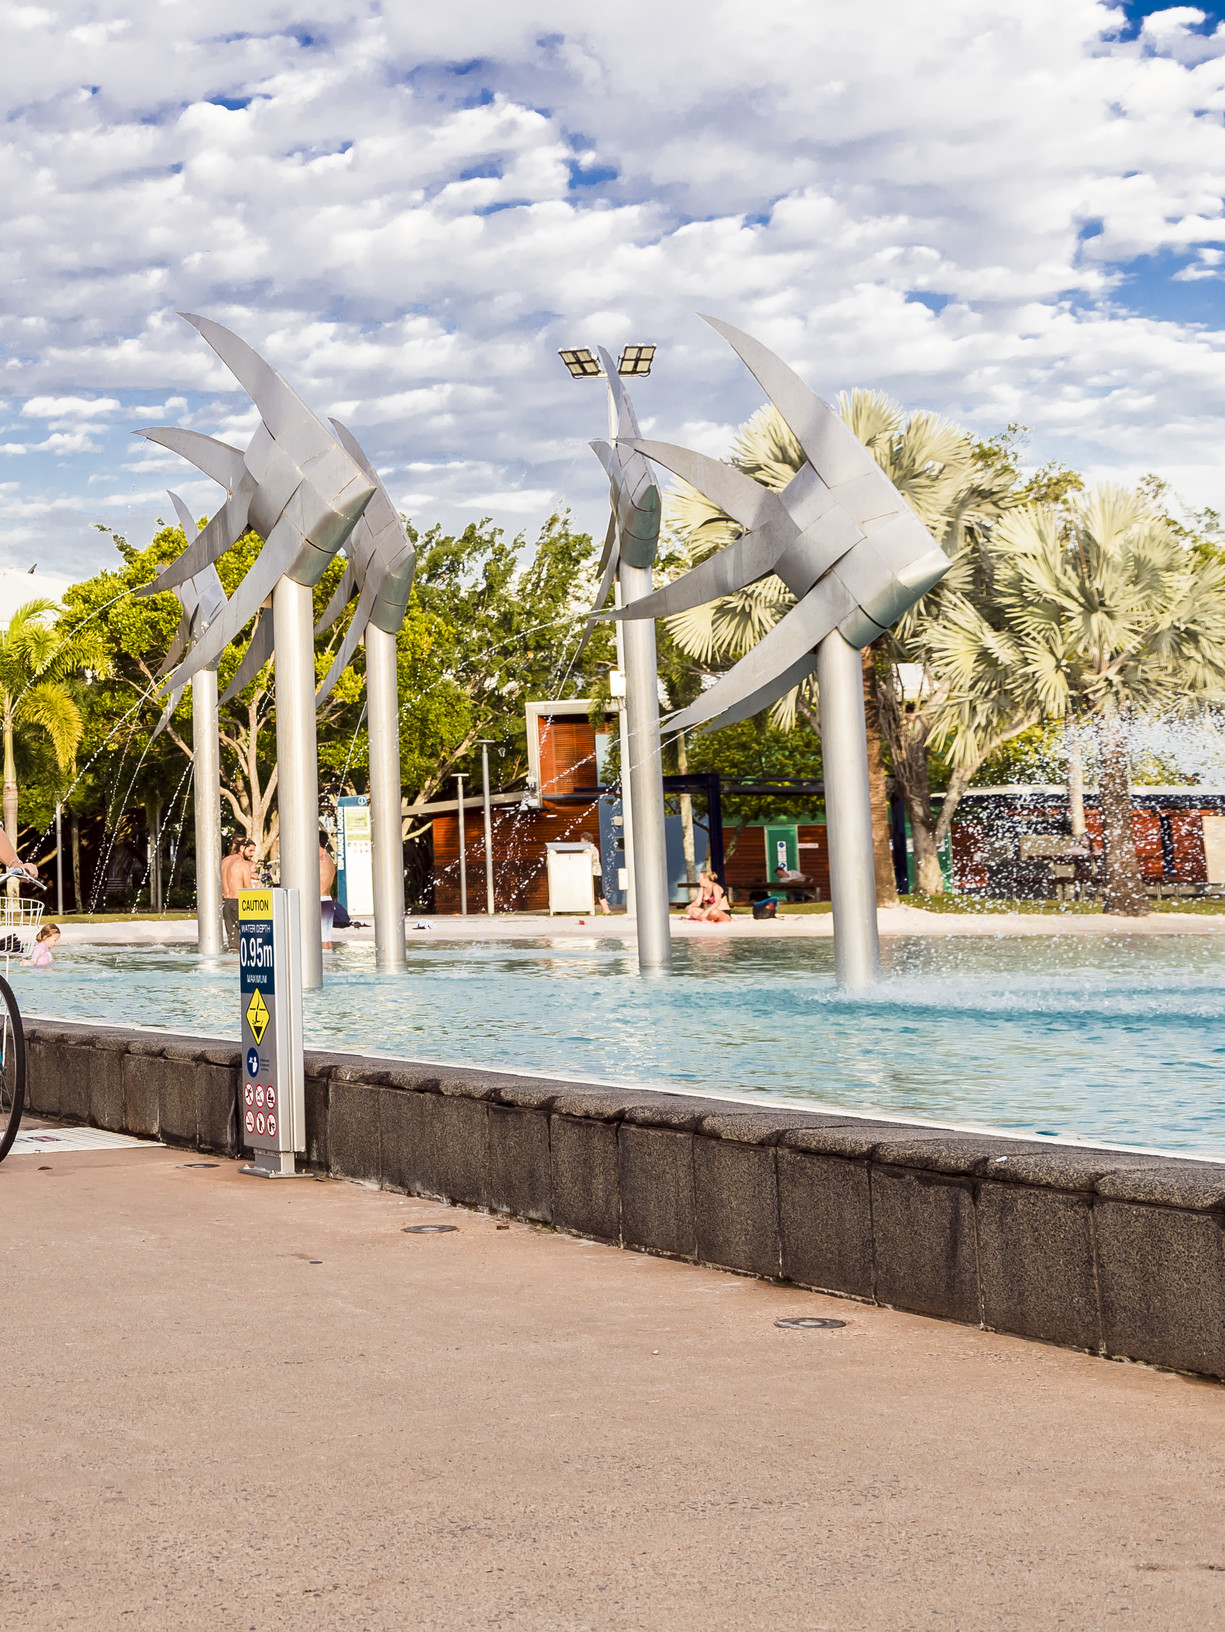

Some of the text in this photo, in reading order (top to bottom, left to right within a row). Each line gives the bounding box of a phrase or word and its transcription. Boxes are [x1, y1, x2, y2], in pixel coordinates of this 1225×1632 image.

[337, 806, 345, 870] ESPLANADE LAGOON
[241, 899, 269, 911] CAUTION
[241, 924, 271, 933] WATER DEPTH
[240, 937, 273, 967] 0.95m
